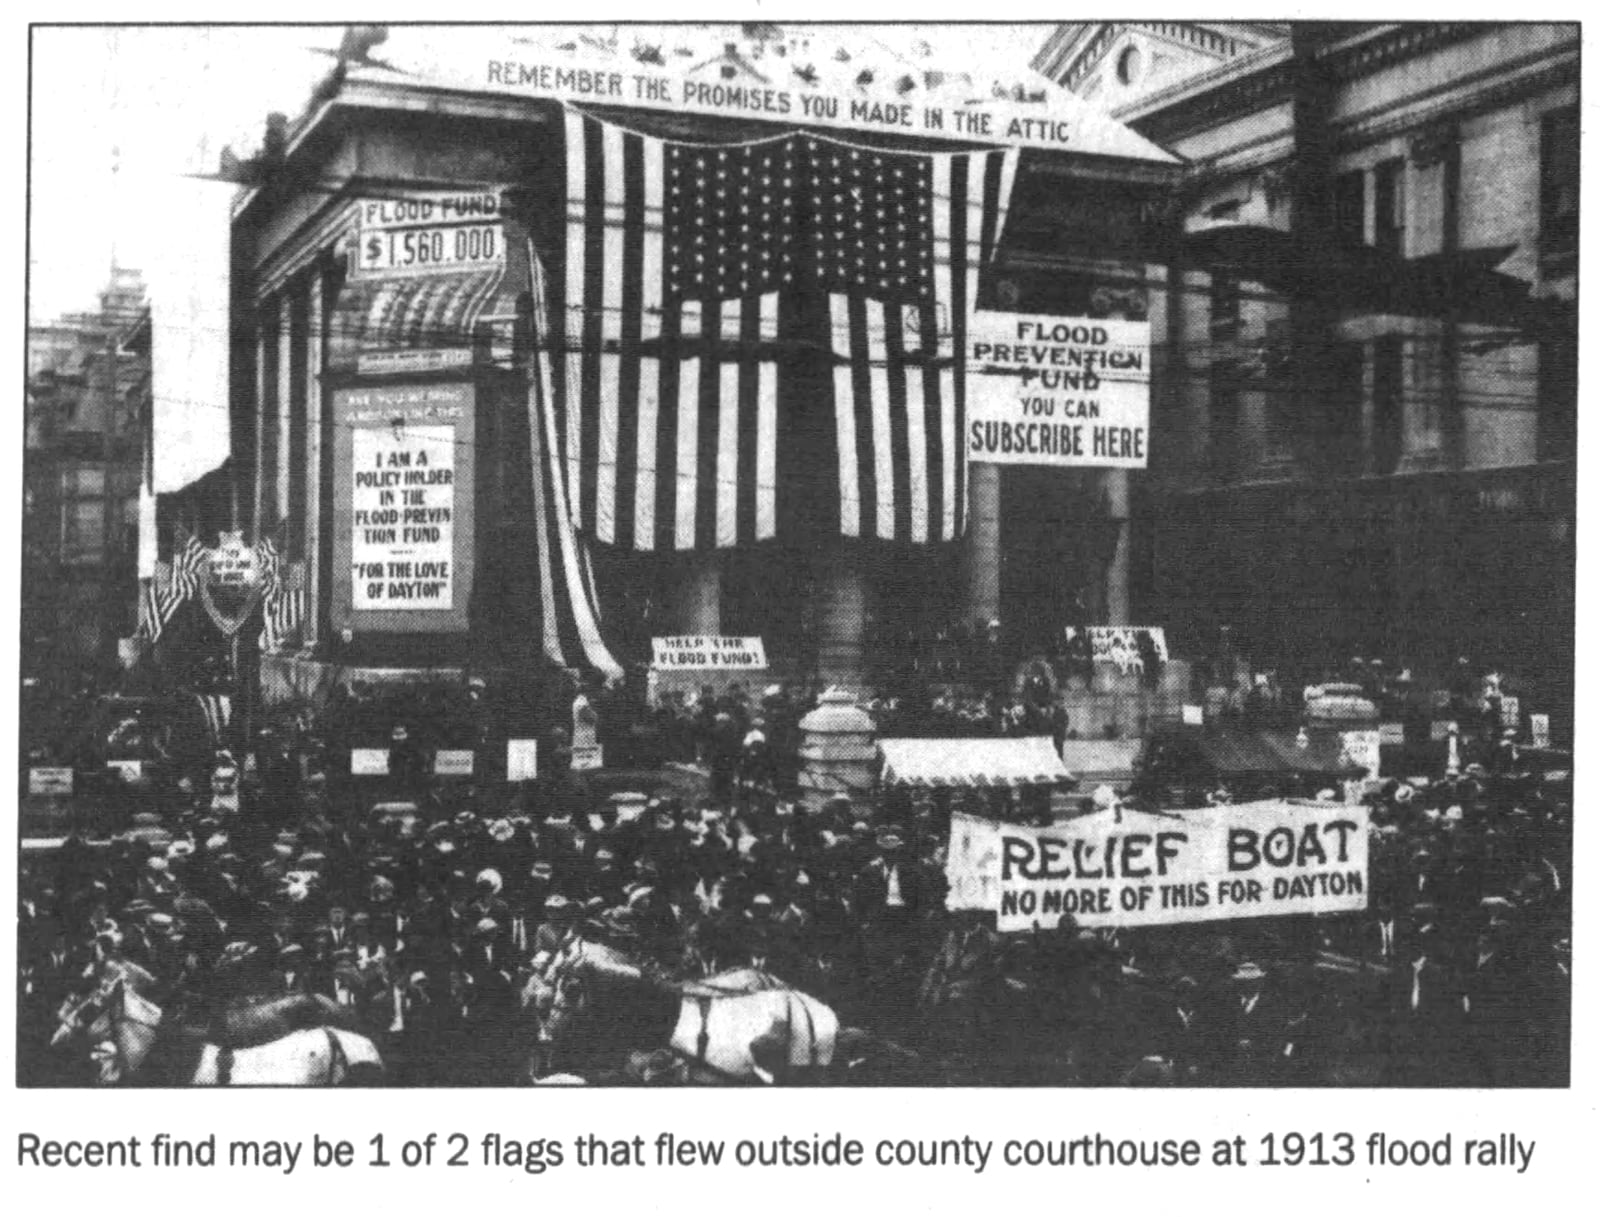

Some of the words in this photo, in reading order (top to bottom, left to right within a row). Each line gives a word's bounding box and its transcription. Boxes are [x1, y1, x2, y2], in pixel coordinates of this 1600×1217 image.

[487, 59, 623, 96] REMEMBER
[632, 75, 672, 102] THE
[683, 81, 792, 114] PROMISES
[800, 96, 838, 119] YOU
[850, 99, 912, 127] MADE
[924, 107, 943, 130] IN
[953, 110, 992, 135] THE
[1006, 117, 1070, 143] ATTIC
[366, 200, 433, 224] FLOOD
[1017, 321, 1109, 346] FLOOD
[1020, 397, 1055, 416] YOU
[1064, 398, 1101, 419] CAN
[971, 419, 1085, 456] SUBSCRIBE
[1092, 426, 1145, 459] HERE
[376, 452, 382, 468] I
[387, 452, 411, 467] AM
[415, 450, 428, 466] A
[356, 471, 401, 487] POLICY
[404, 469, 453, 485] HOLDER
[379, 490, 394, 506] IN
[403, 526, 440, 543] FUND
[387, 561, 411, 578] THE
[414, 561, 448, 578] LOVE
[366, 581, 383, 599] OF
[1001, 832, 1189, 881] RELIEF
[1228, 821, 1358, 871] BOAT
[1001, 889, 1037, 916] NO
[1043, 885, 1112, 914] MORE
[1120, 884, 1151, 911] OF
[1158, 881, 1209, 909] THIS
[1217, 878, 1263, 904] FOR
[1273, 871, 1363, 900] DAYTON
